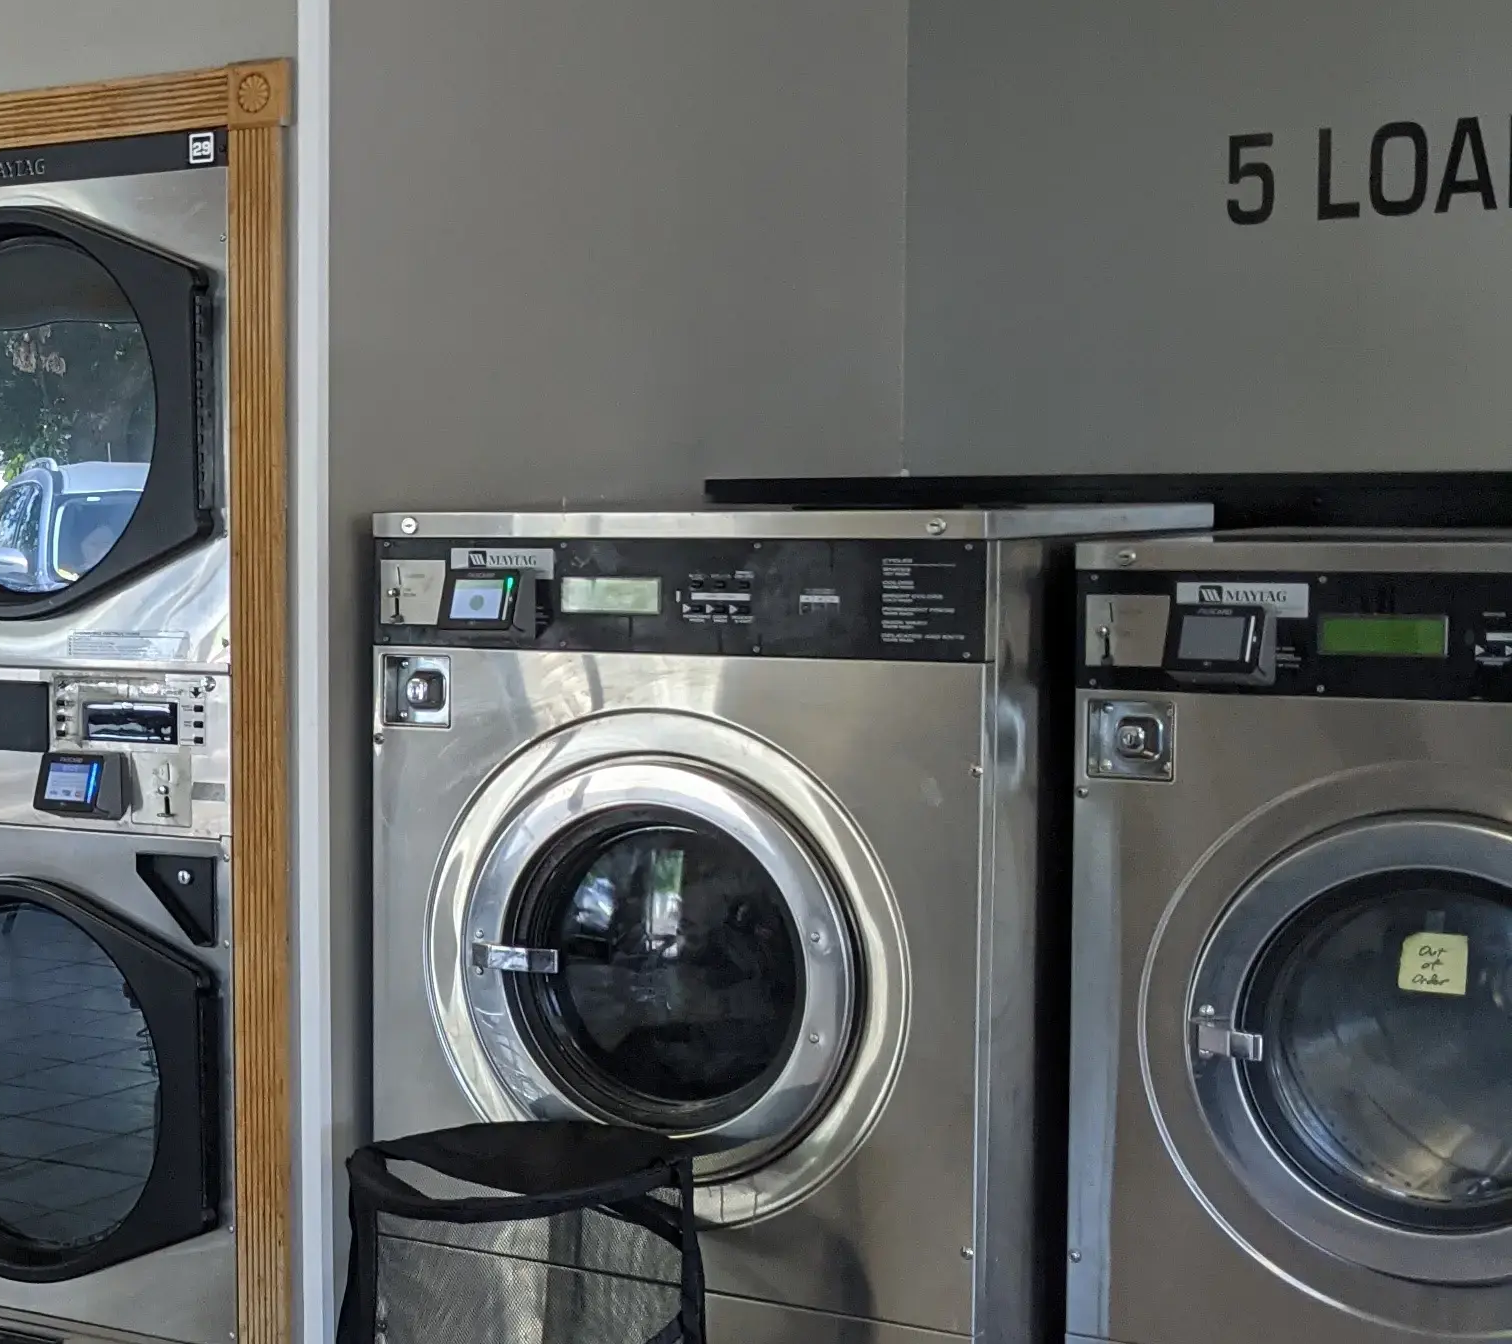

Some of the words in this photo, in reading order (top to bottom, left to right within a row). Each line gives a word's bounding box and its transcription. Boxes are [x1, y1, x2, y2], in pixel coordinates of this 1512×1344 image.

[191, 141, 211, 156] 29
[1226, 132, 1275, 226] 5
[1317, 116, 1512, 221] LOA
[488, 555, 537, 567] MAYTAG
[1226, 590, 1287, 603] MAYTAG
[1418, 945, 1448, 958] Out
[1411, 973, 1450, 986] Order
